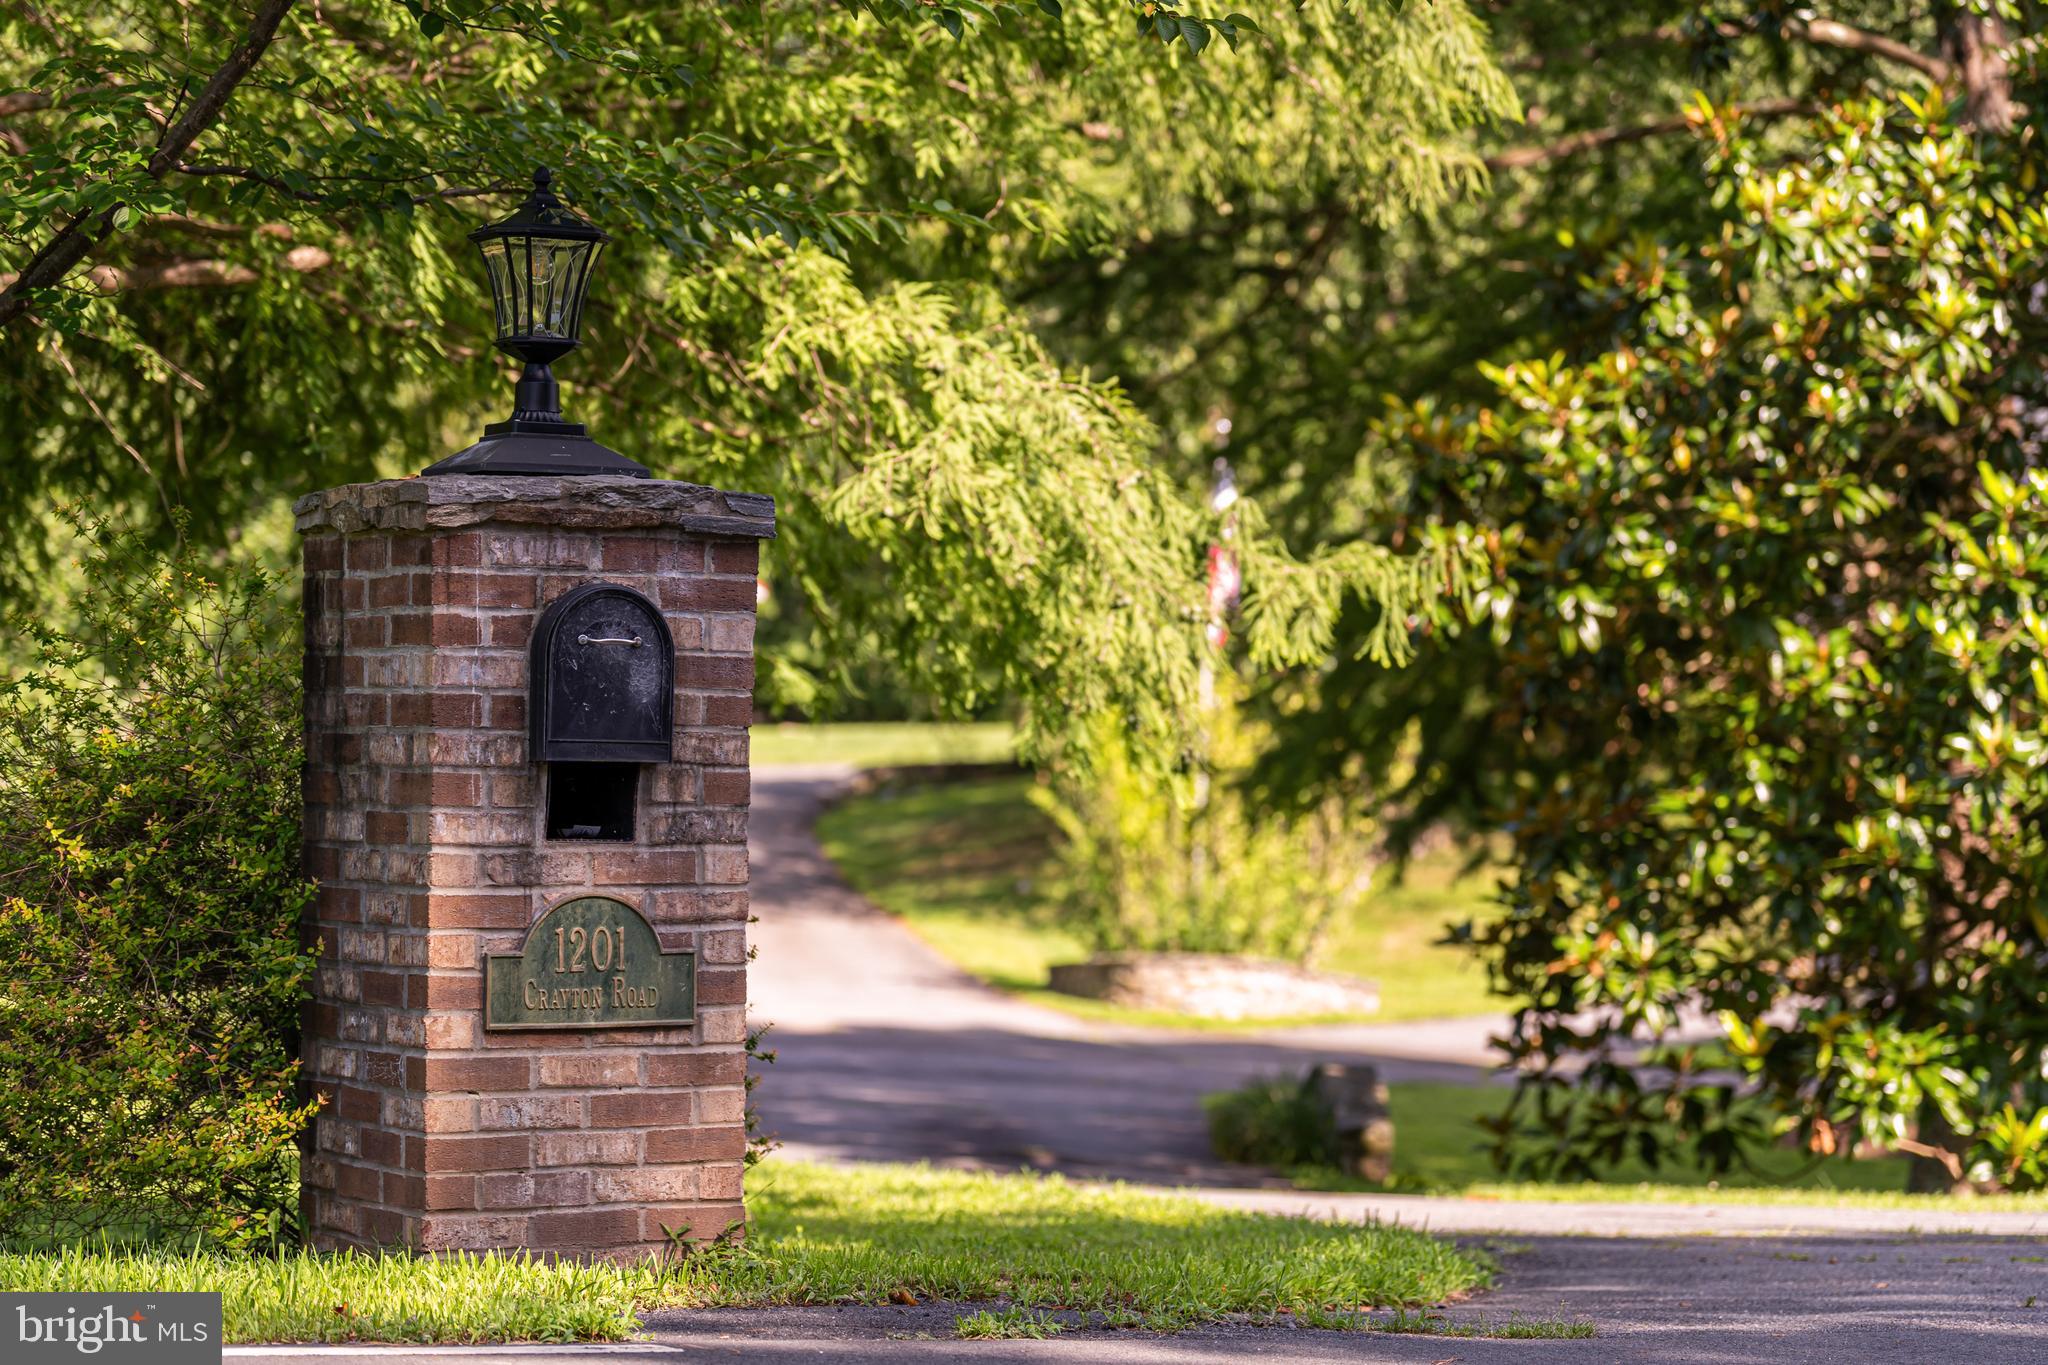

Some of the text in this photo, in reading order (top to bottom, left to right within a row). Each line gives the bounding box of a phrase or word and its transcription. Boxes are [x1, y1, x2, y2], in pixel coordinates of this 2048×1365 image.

[555, 926, 626, 973] 1201
[524, 976, 658, 1010] CRAYTON ROAD
